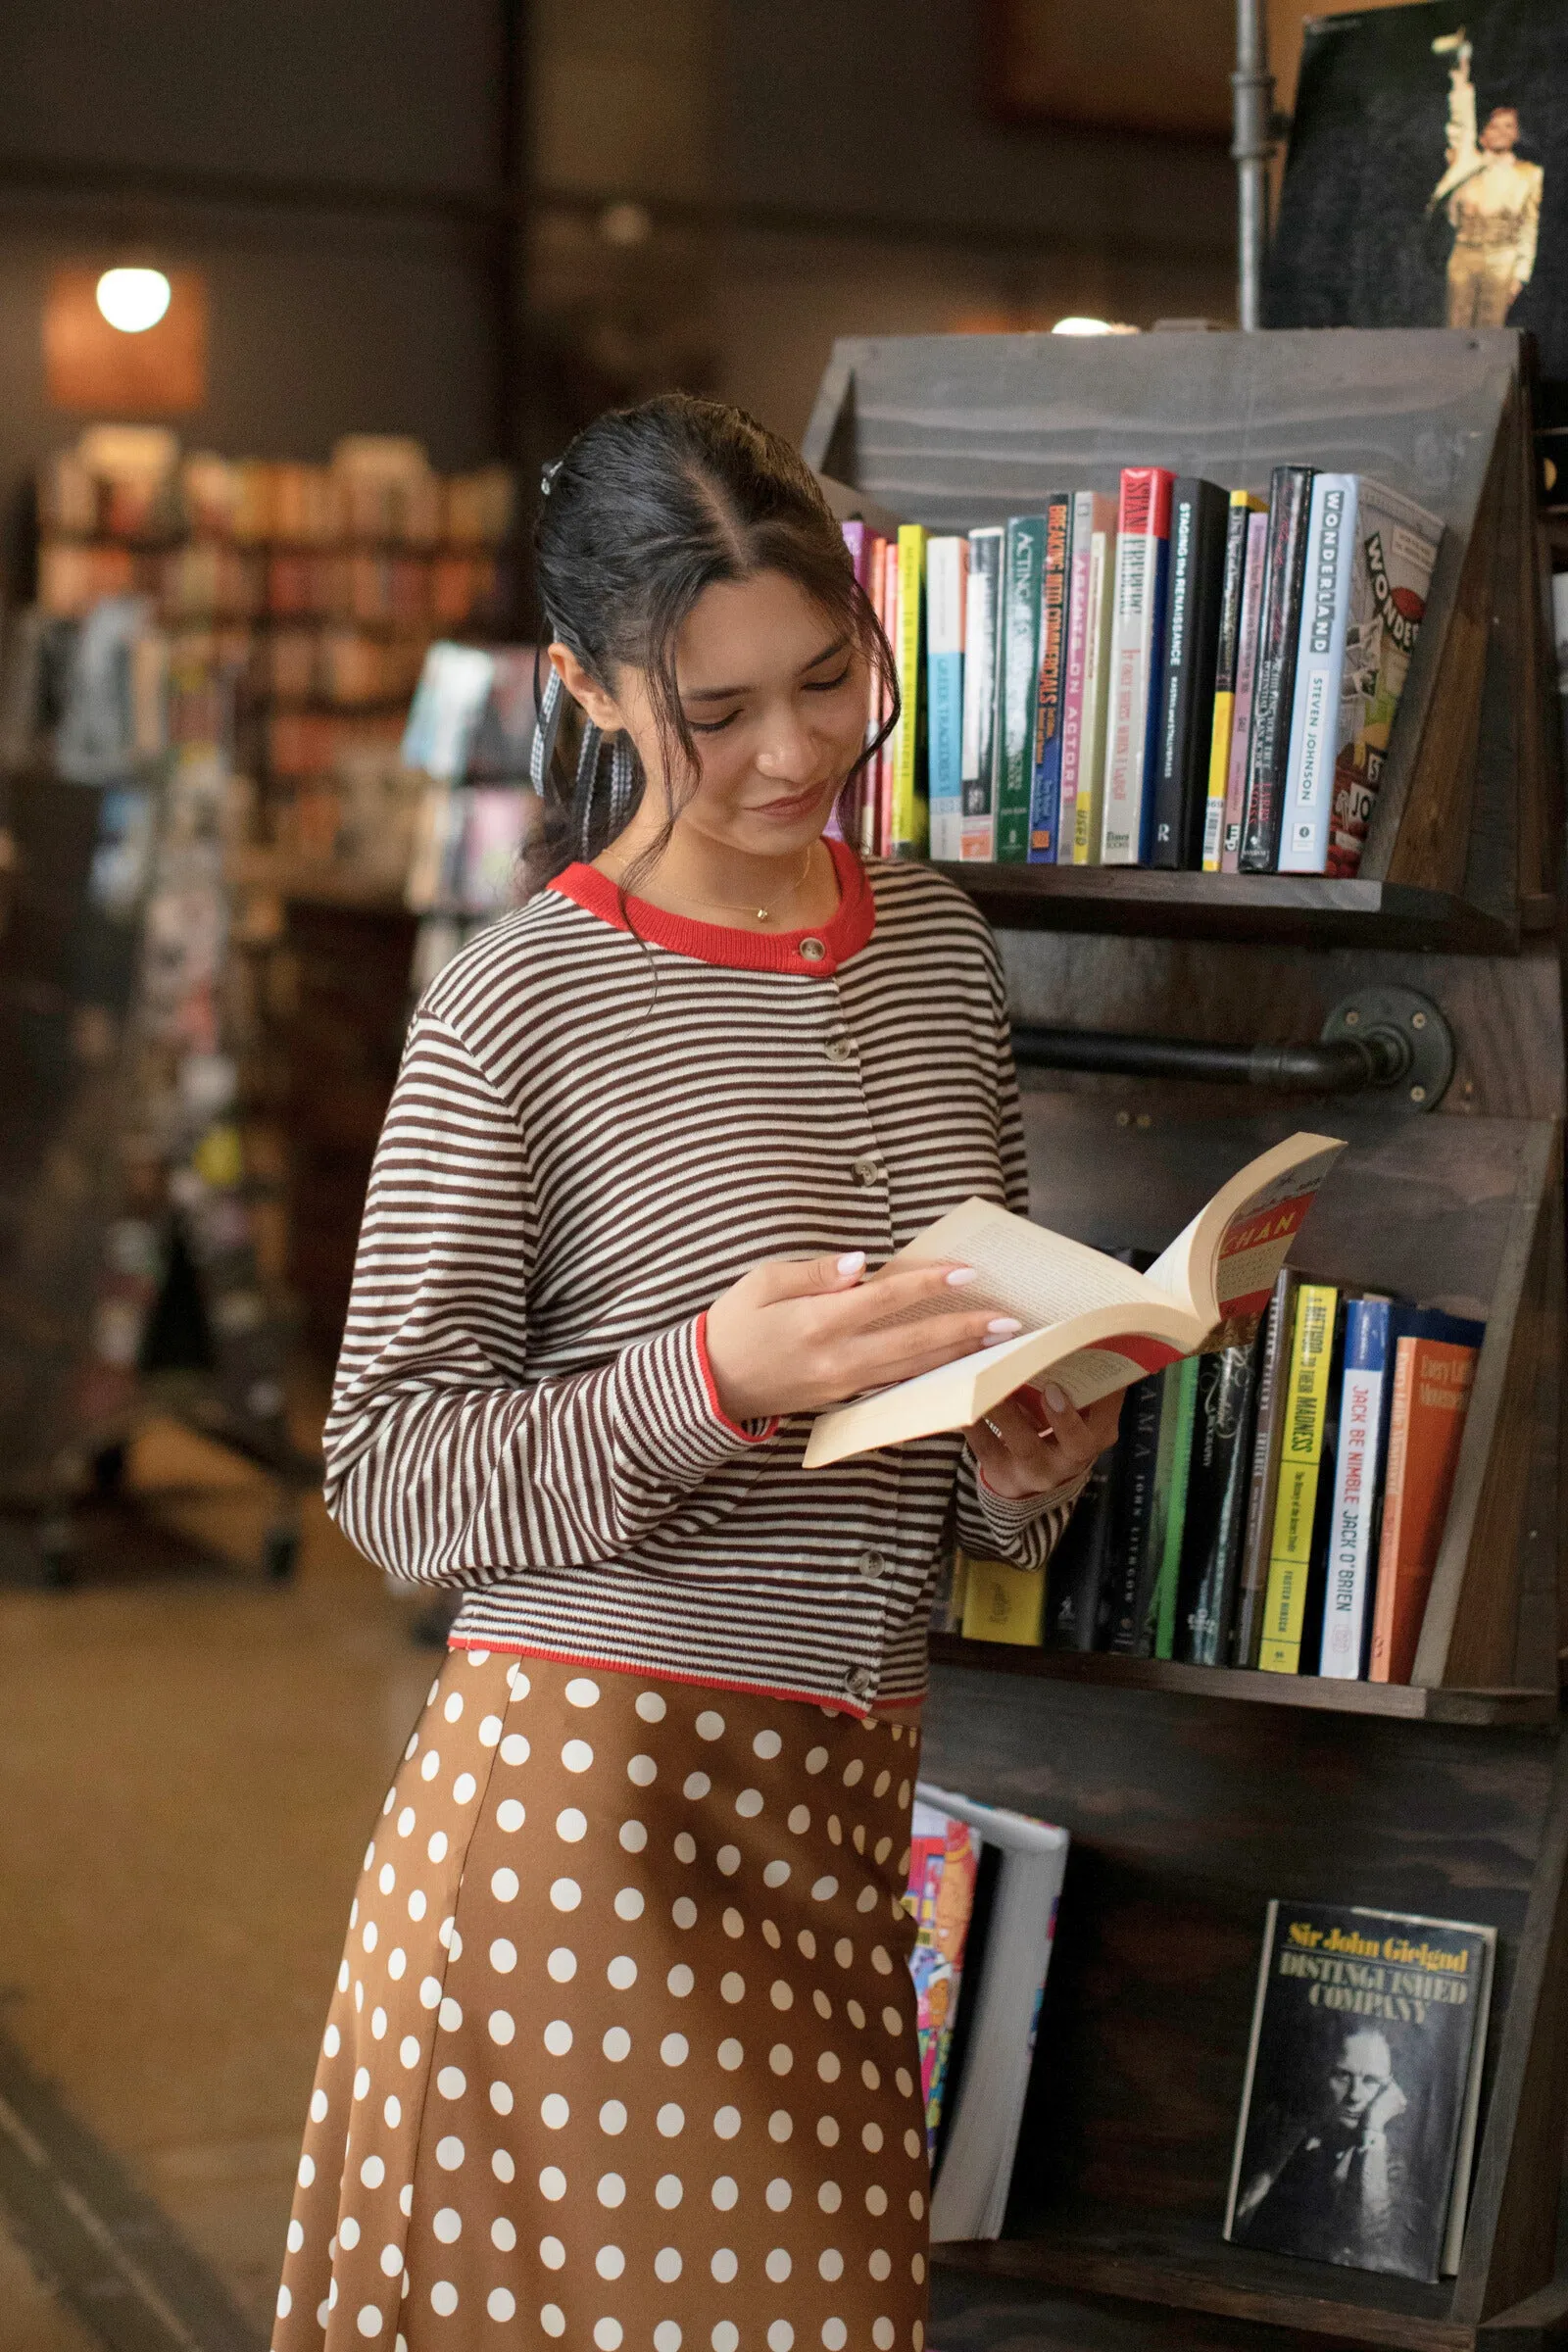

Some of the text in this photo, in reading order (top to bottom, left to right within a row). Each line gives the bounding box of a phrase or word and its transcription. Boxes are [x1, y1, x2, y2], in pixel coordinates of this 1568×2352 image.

[1124, 481, 1150, 528] STAN
[1046, 505, 1067, 570] BREAKING
[1046, 573, 1064, 605] INTO
[1170, 503, 1191, 666] STAGING the RENAISSANCE
[1314, 491, 1341, 652] WONDERLAND
[1039, 608, 1062, 704] COMMERCIALS
[1069, 662, 1081, 694] ON
[1063, 707, 1078, 798] ACTORS
[1301, 677, 1323, 801] STEVEN JOHNSON
[1075, 809, 1088, 846] USED
[1298, 1370, 1315, 1394] THEIR
[1292, 1396, 1318, 1453] MADNESS
[1344, 1386, 1369, 1503] JACK BE NIMBLE
[1133, 1474, 1146, 1517] JOHN
[1341, 1510, 1359, 1548] JACK
[1124, 1527, 1140, 1602] LITHGOW
[1336, 1553, 1356, 1612] O'BRIEN
[1289, 1922, 1323, 1948] Sir
[1324, 1928, 1380, 1958] John
[1279, 1951, 1468, 2005] DISTINGUISHED
[1308, 1983, 1430, 2024] COMPANY
